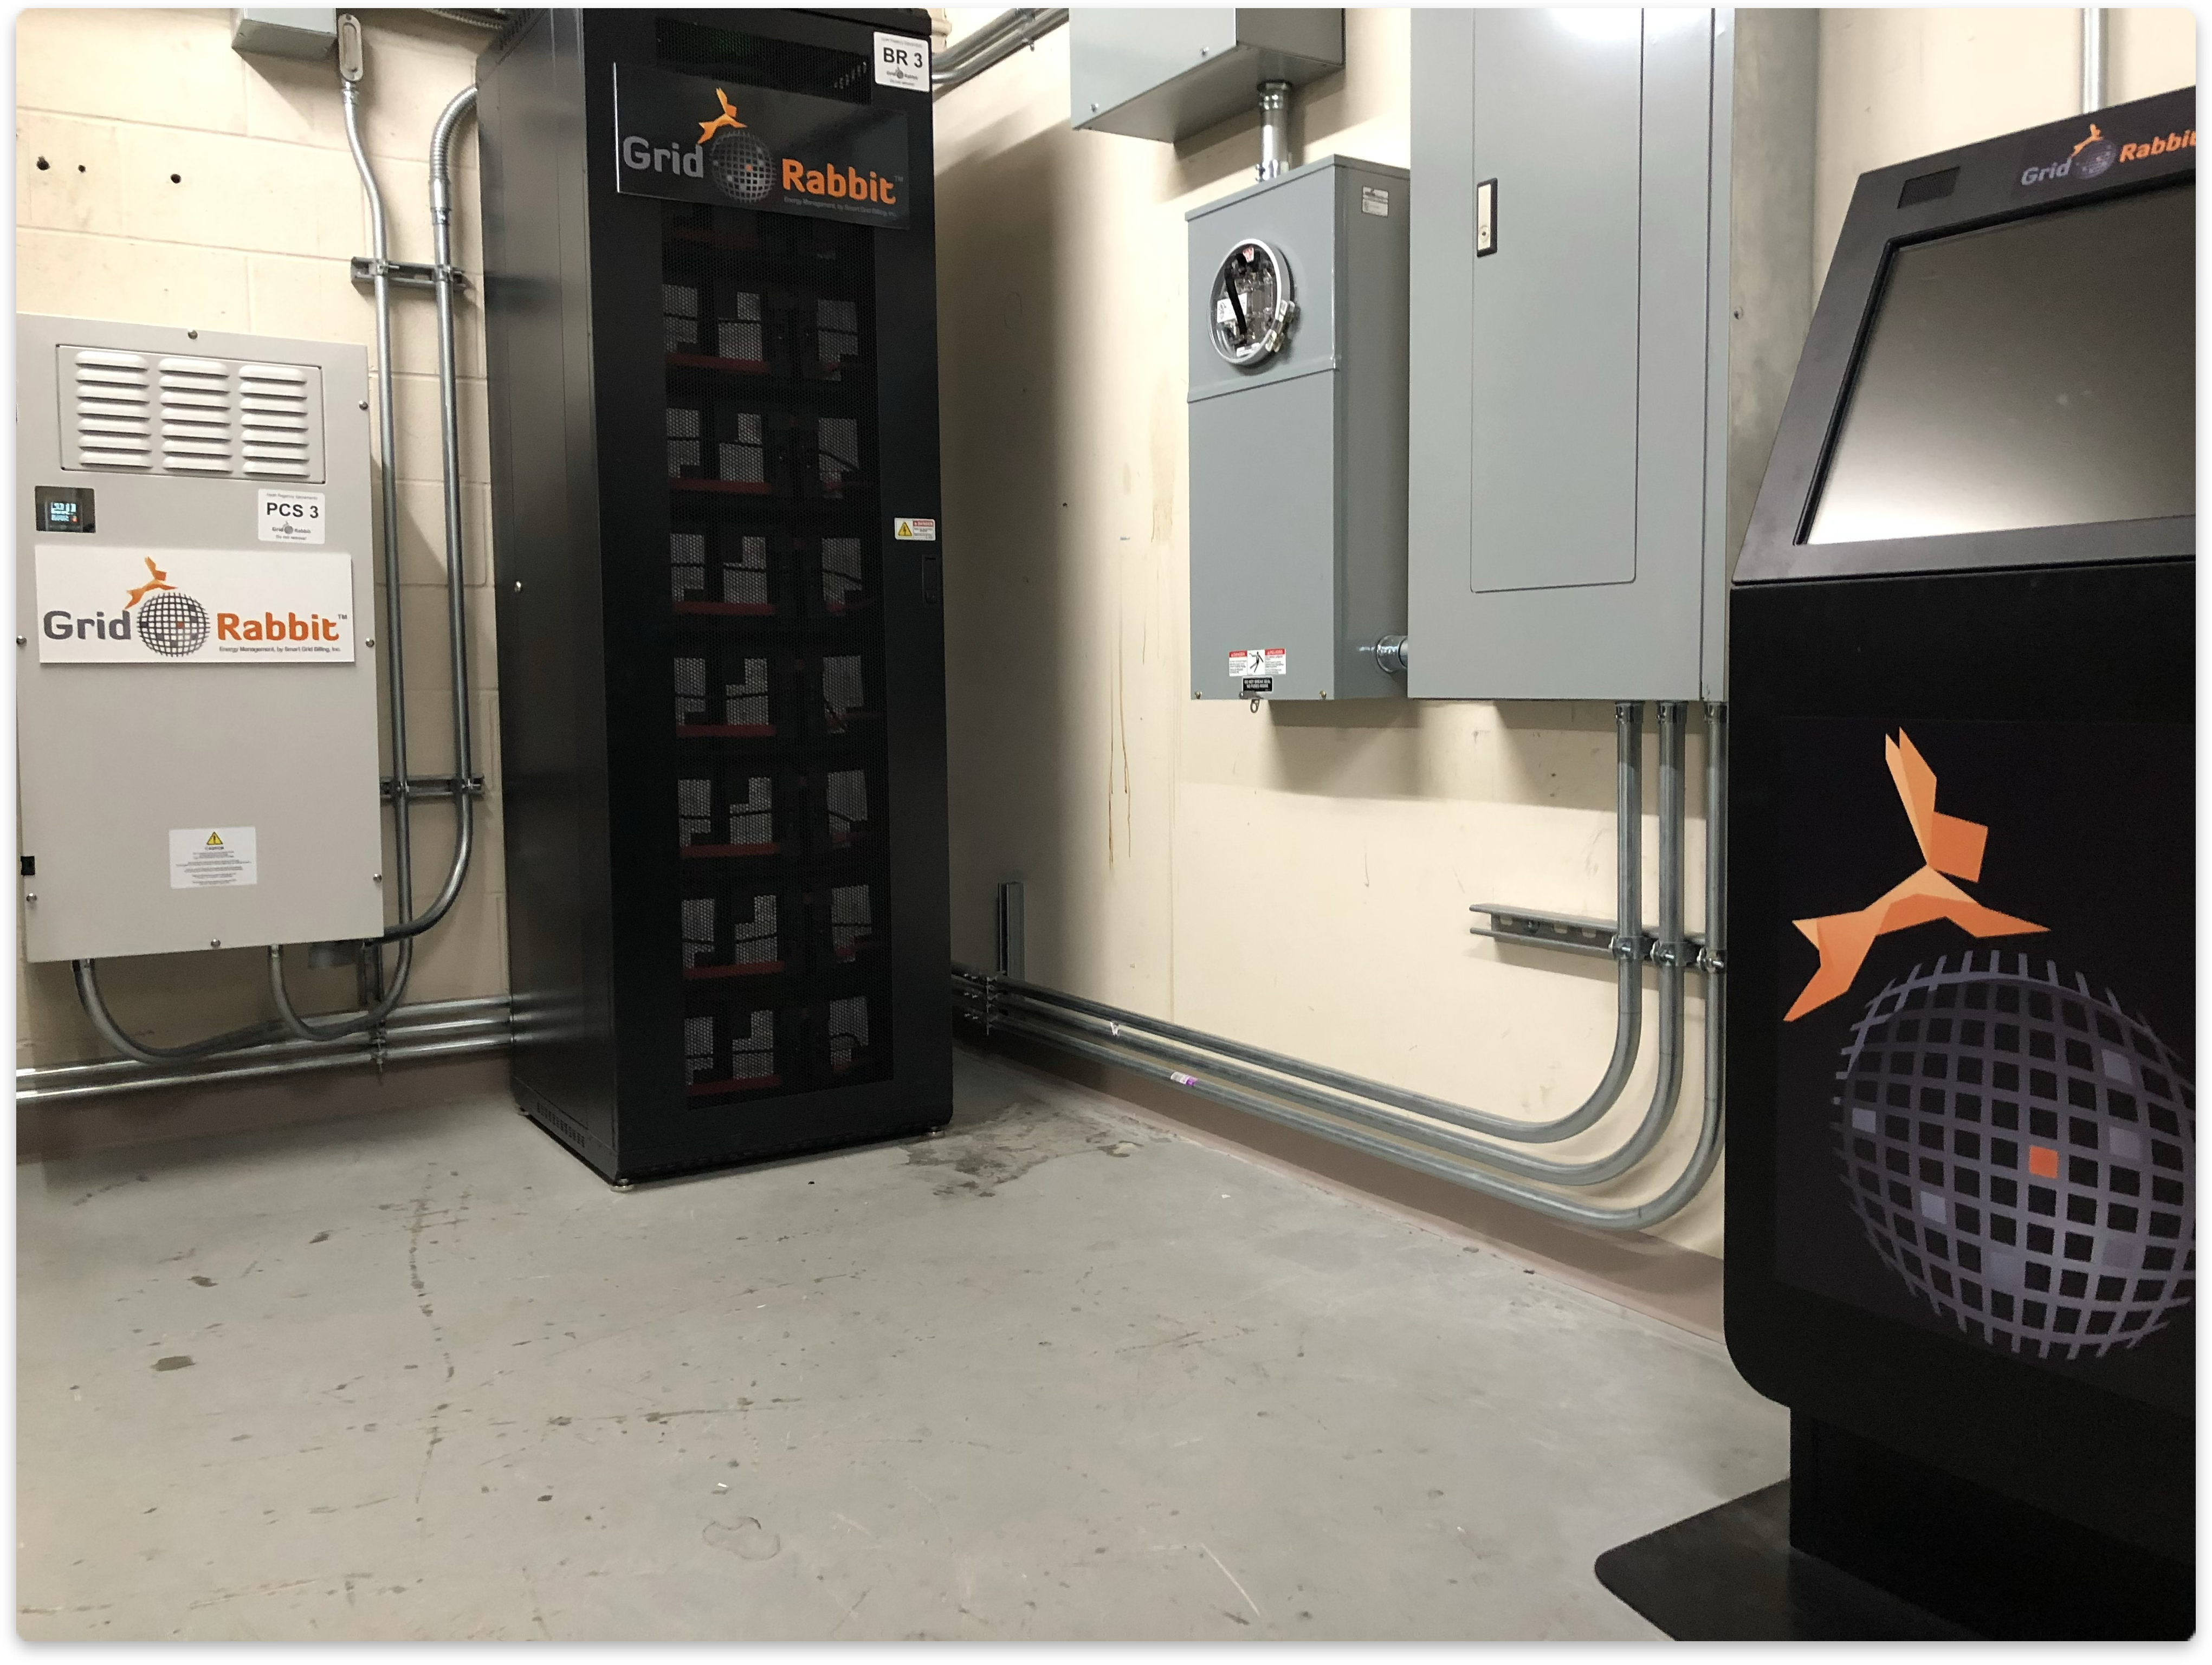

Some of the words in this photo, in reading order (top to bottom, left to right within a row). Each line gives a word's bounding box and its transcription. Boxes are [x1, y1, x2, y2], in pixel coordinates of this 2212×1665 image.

[883, 47, 908, 66] BR
[914, 53, 922, 68] 3
[623, 136, 704, 178] Grid
[782, 158, 896, 205] Rabbit
[2021, 158, 2072, 185] Grid
[267, 502, 303, 517] PCS
[310, 506, 319, 519] 3
[43, 610, 131, 640] Grid
[217, 612, 339, 641] Rabbit
